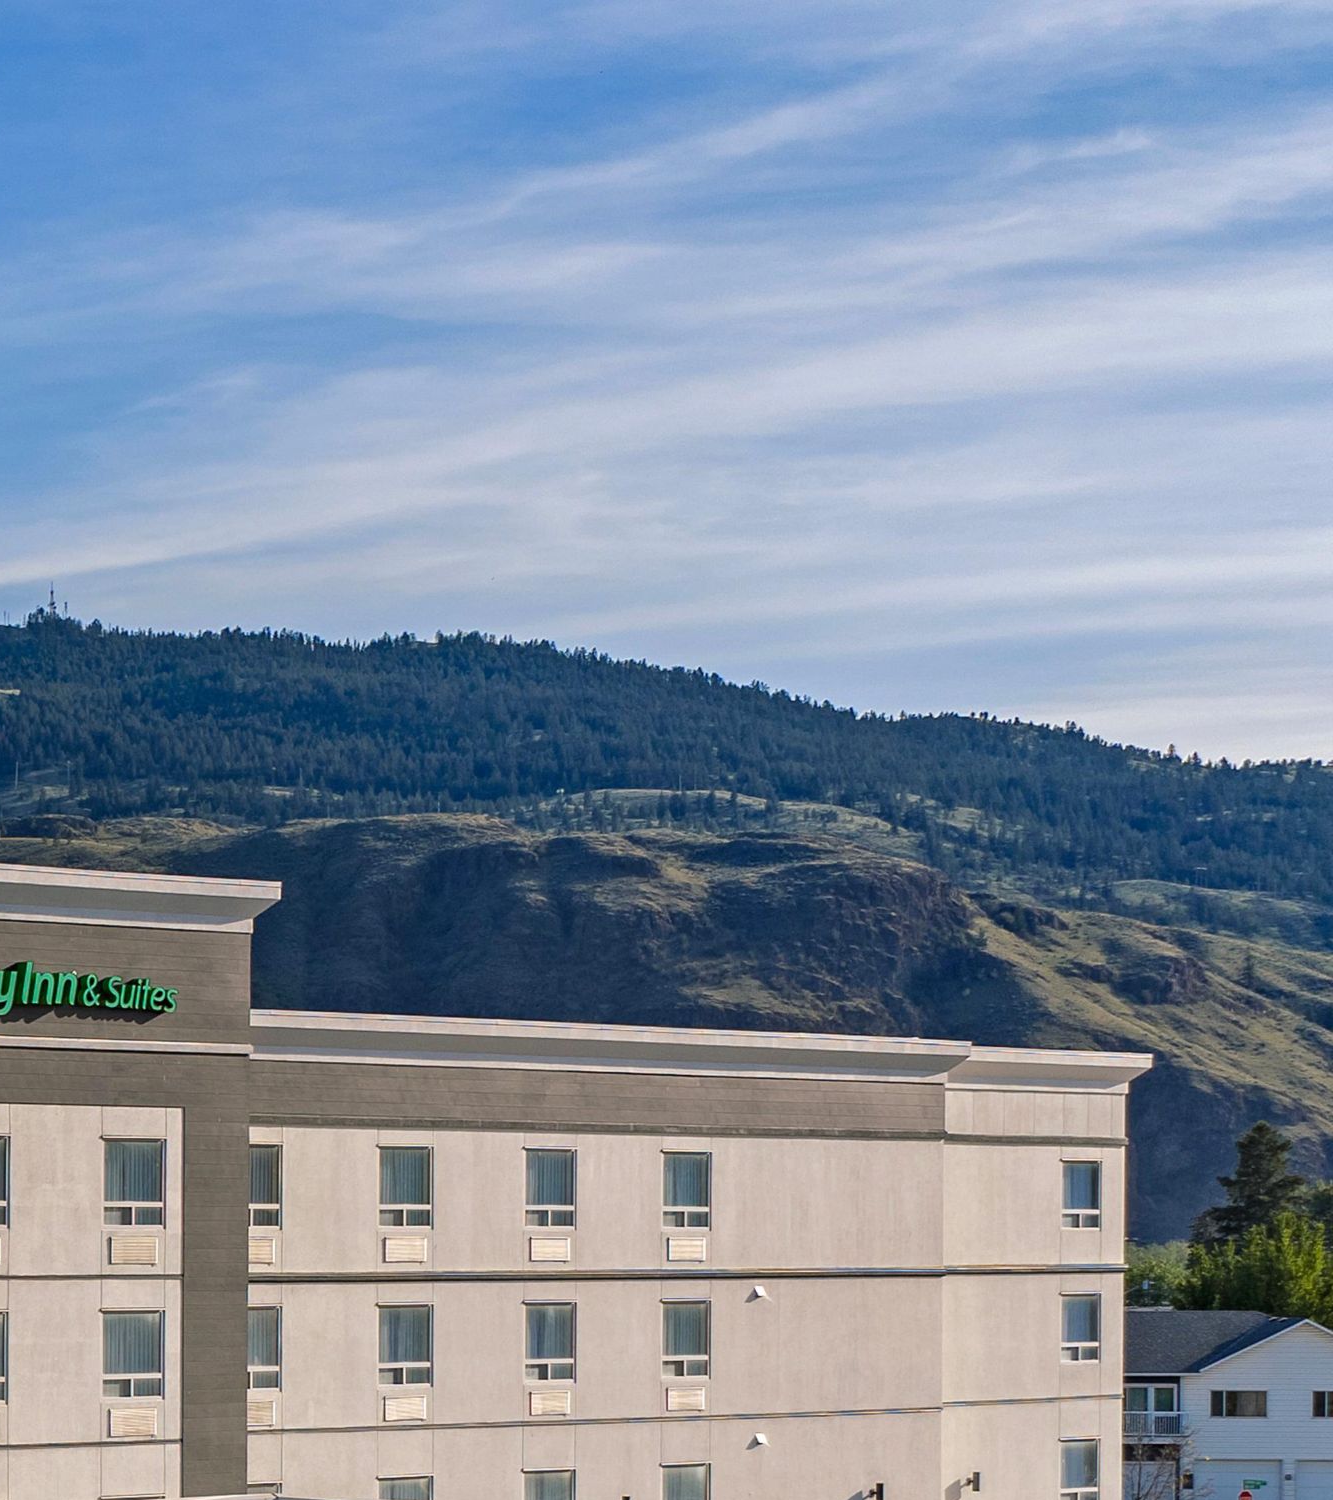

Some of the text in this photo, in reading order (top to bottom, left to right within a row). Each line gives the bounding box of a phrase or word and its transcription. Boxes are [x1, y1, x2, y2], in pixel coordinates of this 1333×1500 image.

[20, 960, 79, 1006] Inn
[82, 974, 100, 1007] &
[104, 975, 180, 1014] Suites
